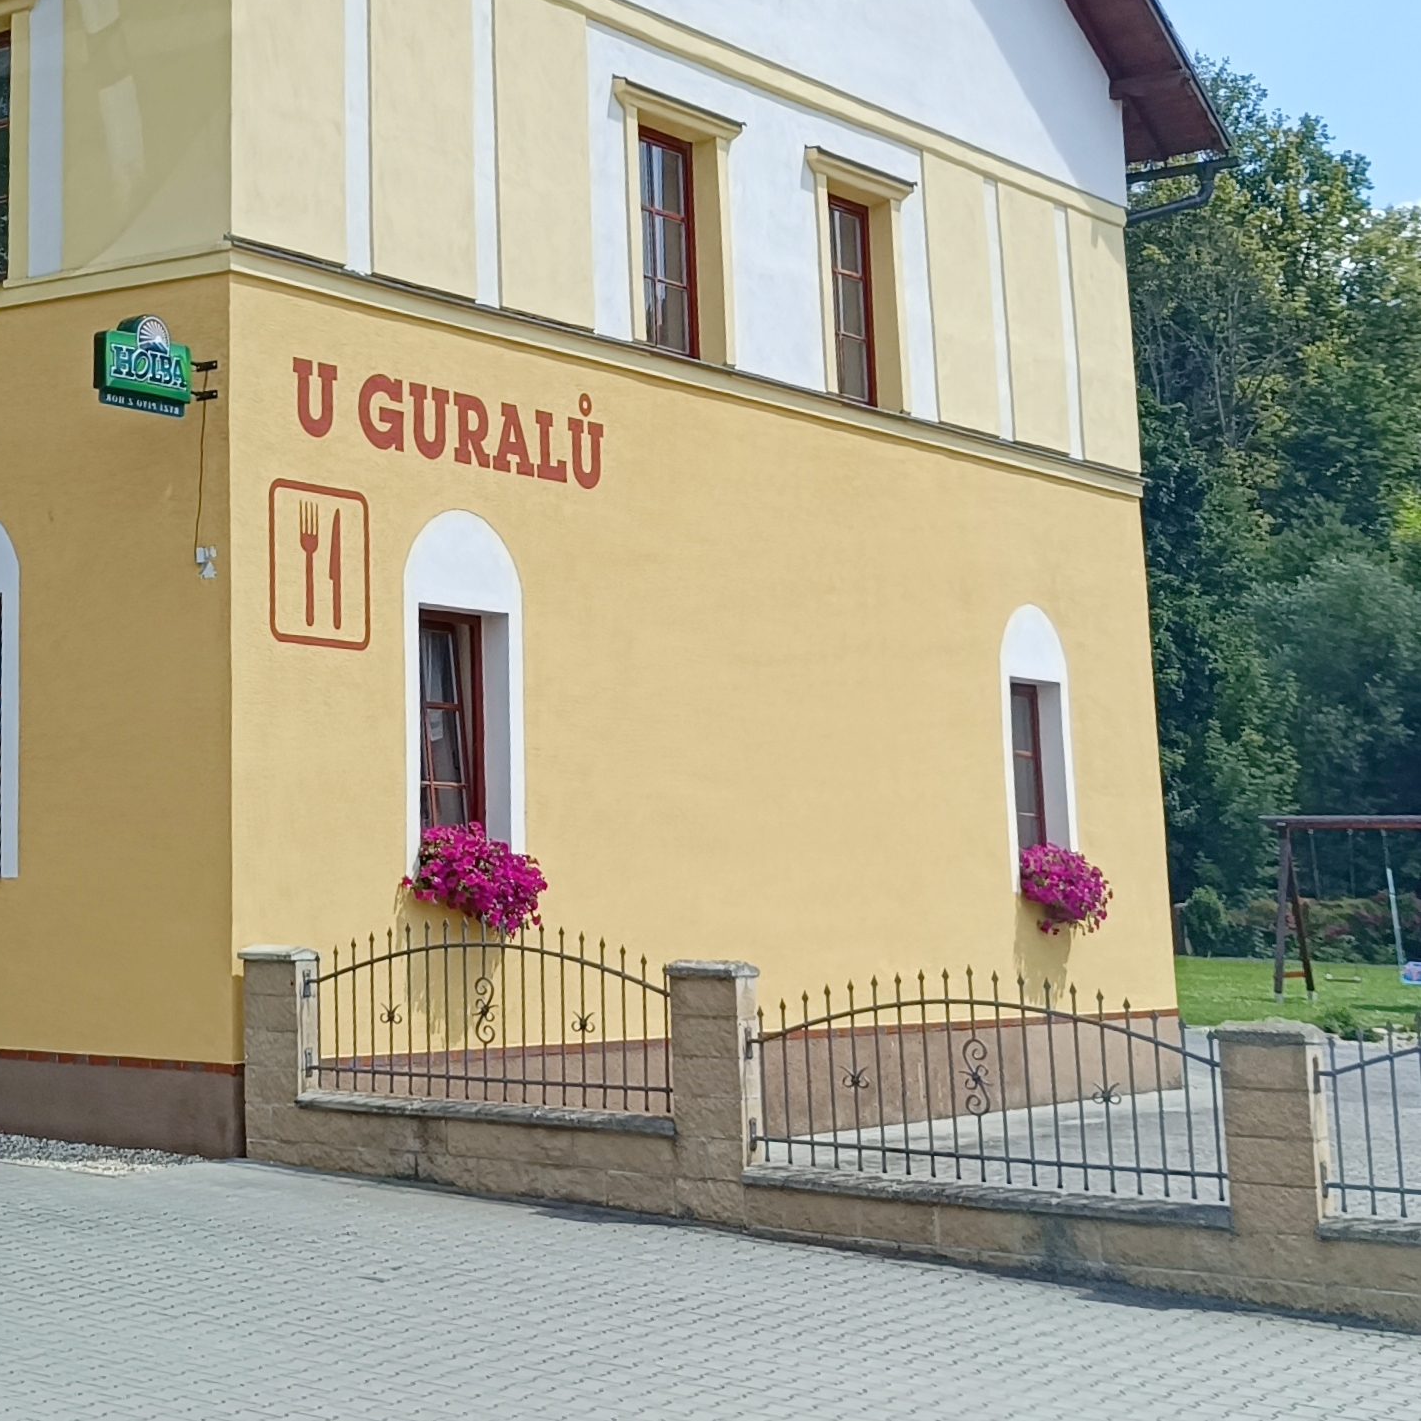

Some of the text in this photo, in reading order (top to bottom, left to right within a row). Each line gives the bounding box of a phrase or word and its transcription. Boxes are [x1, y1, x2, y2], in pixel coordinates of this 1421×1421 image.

[111, 343, 187, 391] HOLBA
[293, 357, 604, 489] U GURALŮ
